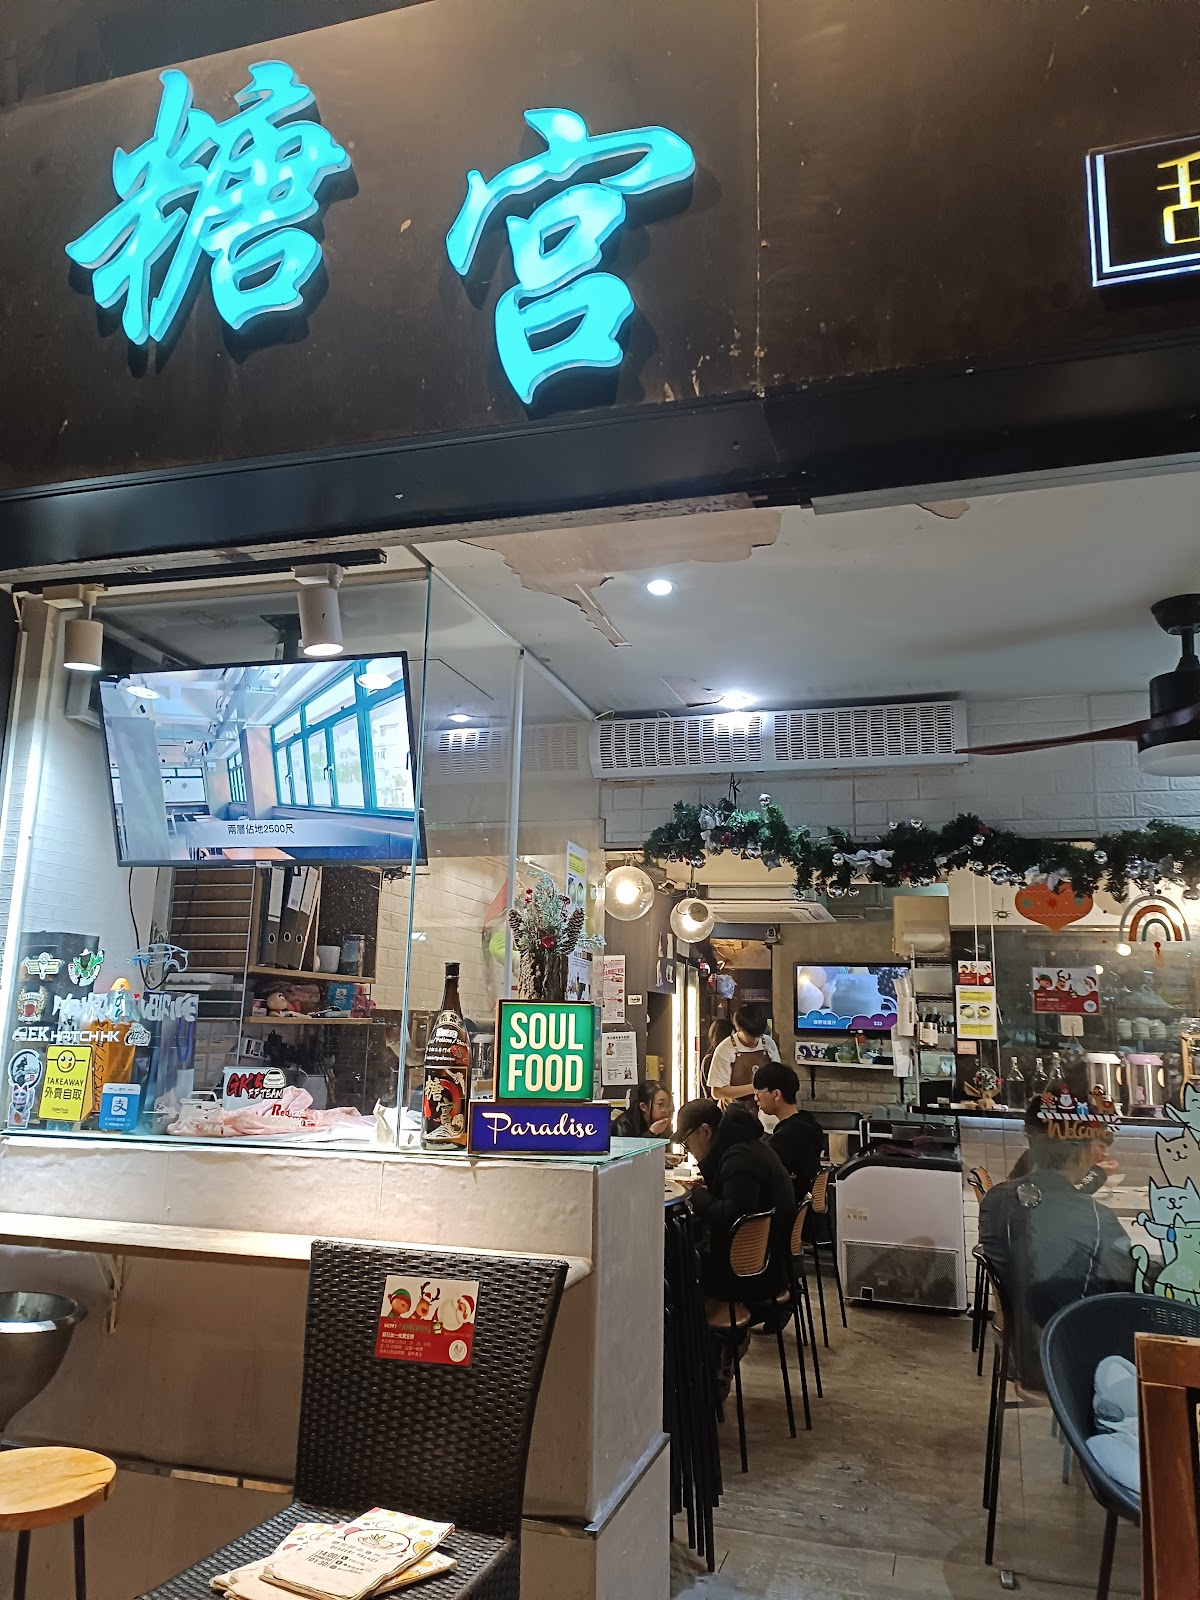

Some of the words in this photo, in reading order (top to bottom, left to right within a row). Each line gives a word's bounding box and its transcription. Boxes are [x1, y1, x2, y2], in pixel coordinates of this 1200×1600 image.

[101, 1030, 120, 1042] HK
[509, 1011, 584, 1051] SOUL
[46, 1076, 85, 1087] TAKEAWAY
[507, 1053, 584, 1093] FOOD
[44, 1086, 82, 1100] 外賣自取
[481, 1112, 598, 1145] Paradise
